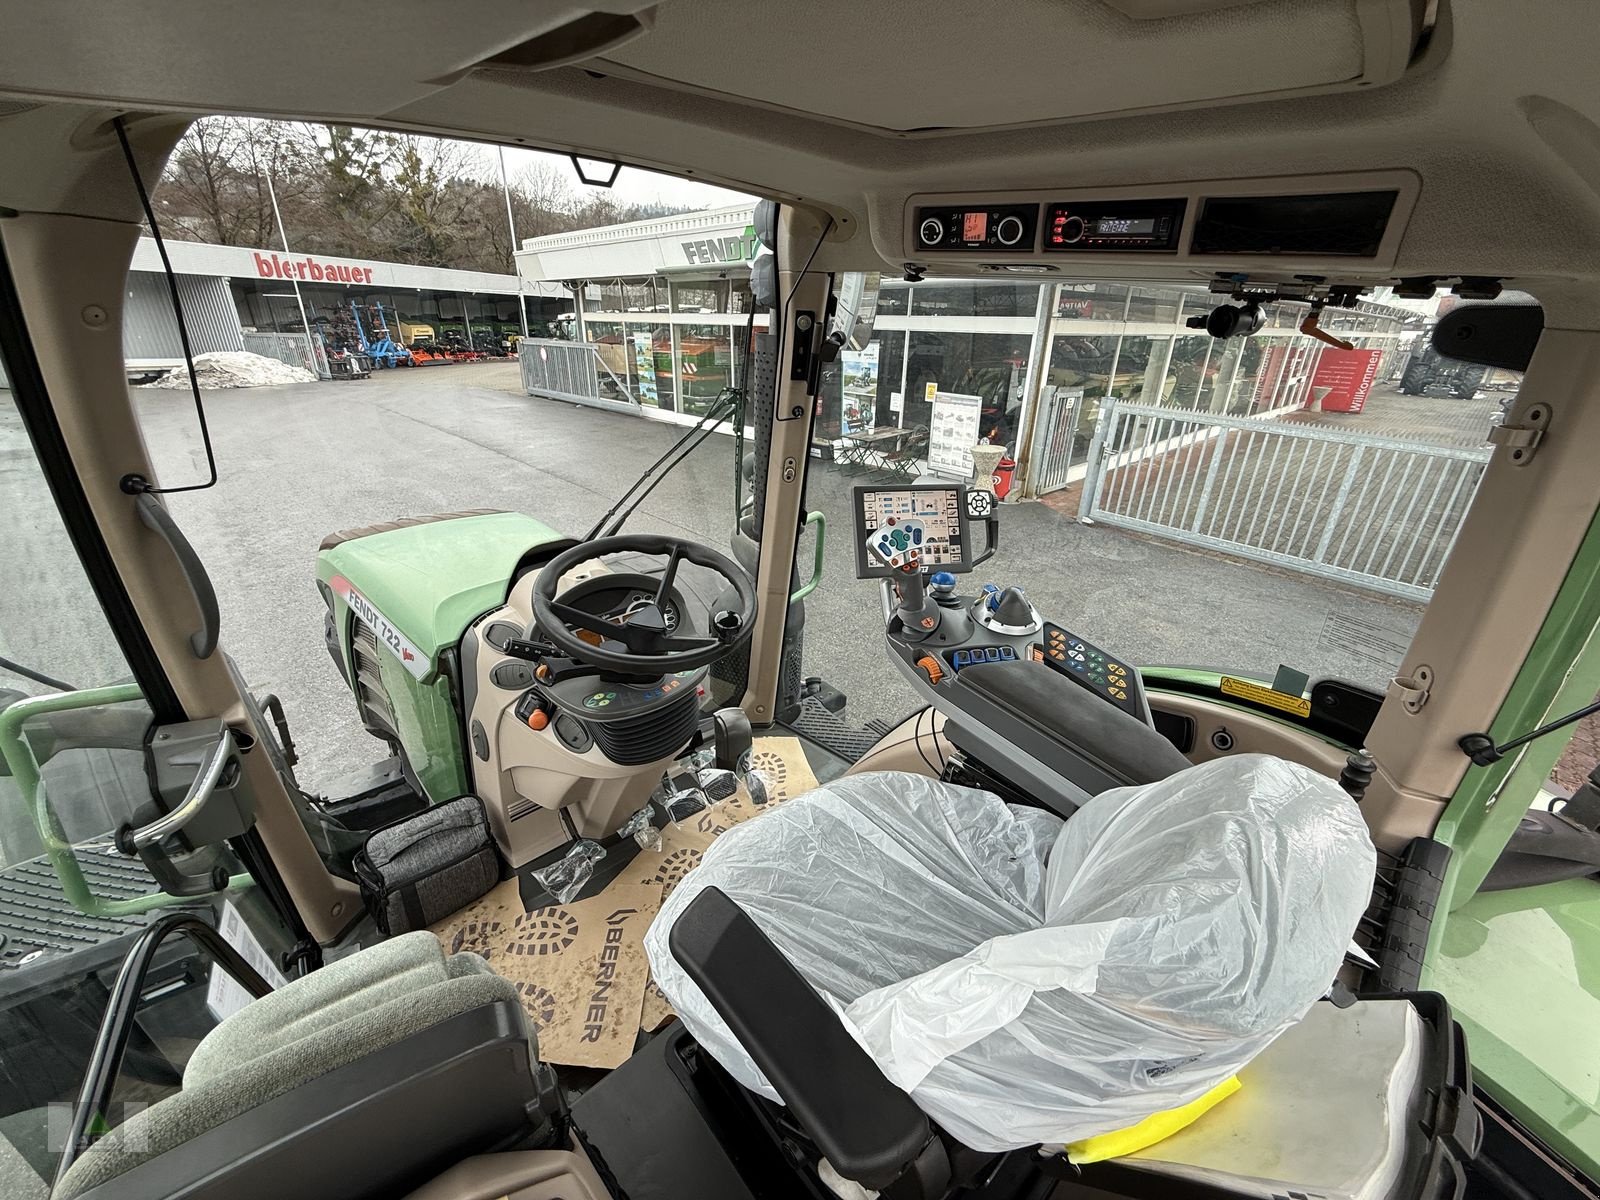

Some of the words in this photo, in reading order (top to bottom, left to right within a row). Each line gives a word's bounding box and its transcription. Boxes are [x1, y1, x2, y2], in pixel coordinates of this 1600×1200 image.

[253, 251, 373, 284] bierbauer
[681, 234, 756, 265] FENDT
[1349, 350, 1381, 412] Willkommen
[349, 588, 379, 629] FENDT
[381, 621, 401, 654] 722
[579, 927, 624, 1044] BERNER
